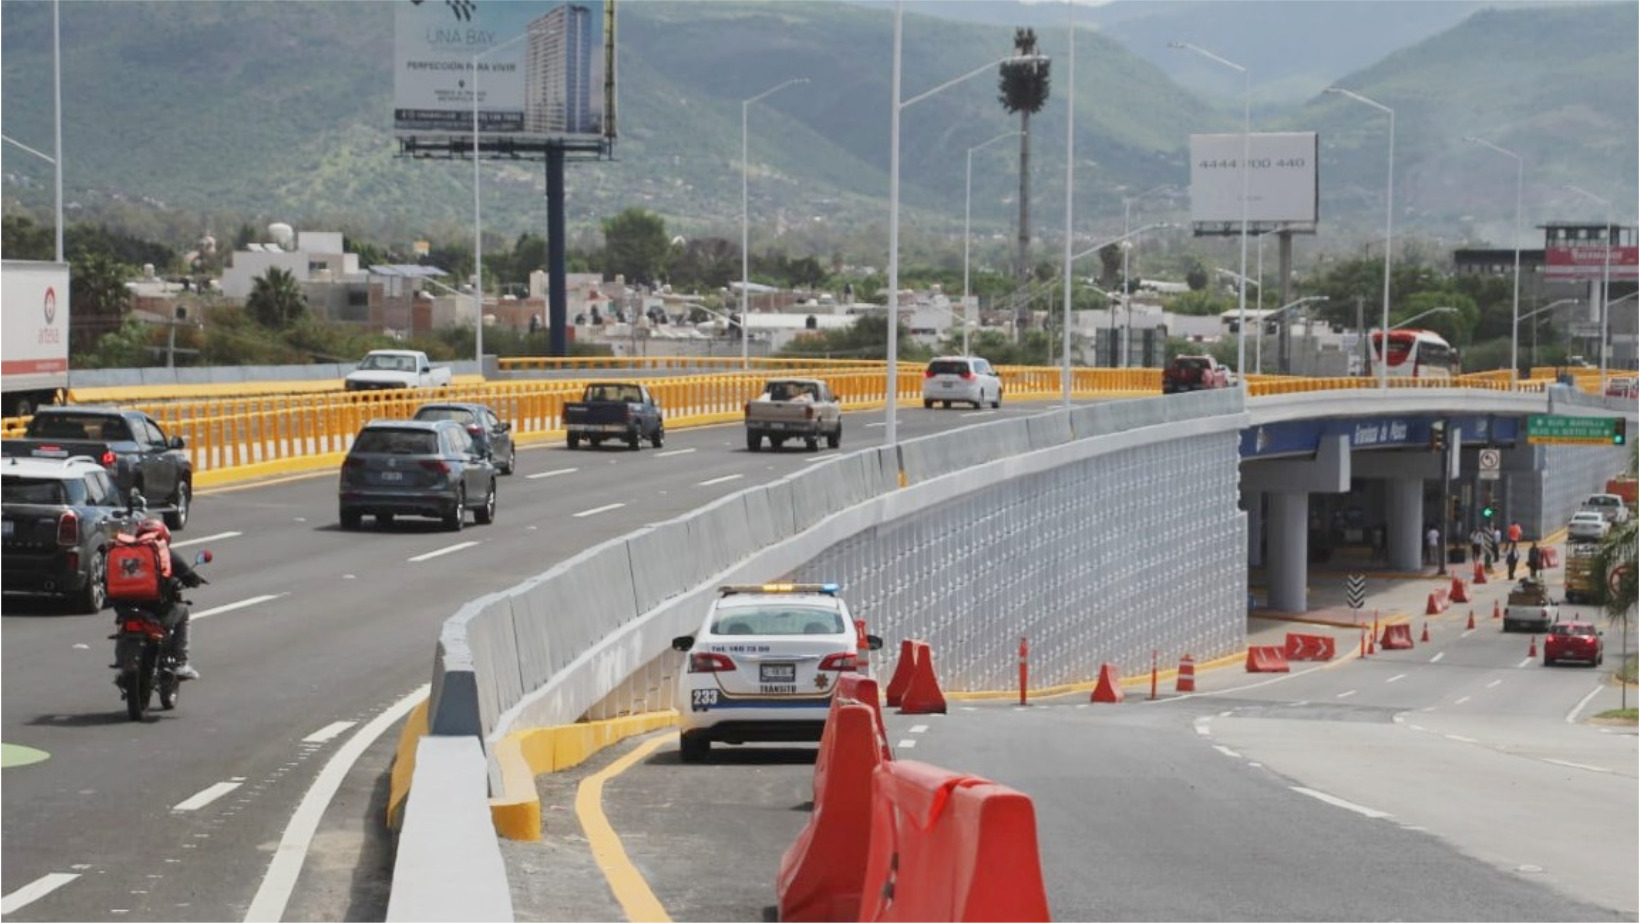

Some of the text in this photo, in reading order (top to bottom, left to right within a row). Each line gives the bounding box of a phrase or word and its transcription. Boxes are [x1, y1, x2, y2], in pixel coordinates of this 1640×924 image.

[426, 29, 497, 45] UNA BAY
[693, 690, 719, 705] 233
